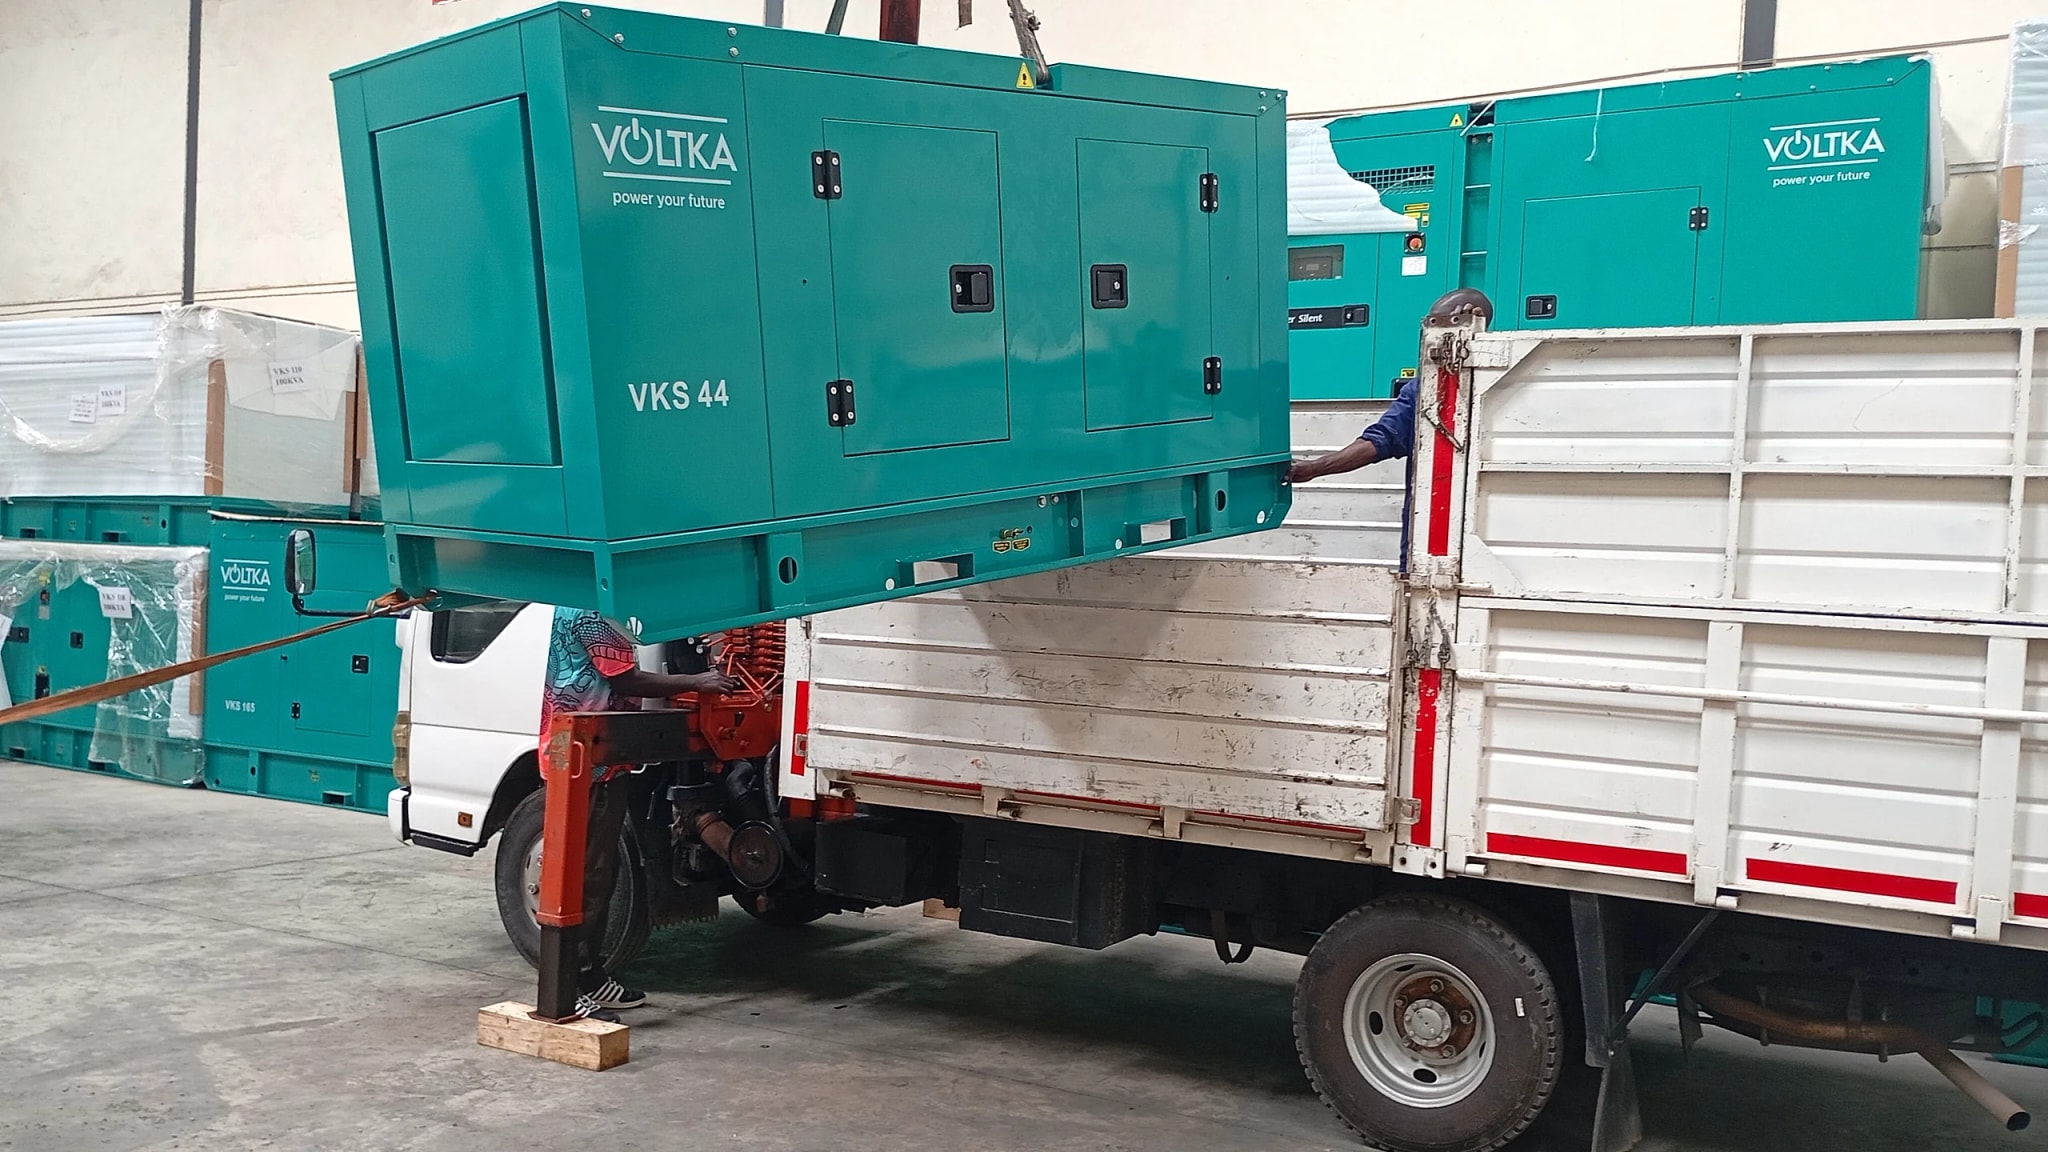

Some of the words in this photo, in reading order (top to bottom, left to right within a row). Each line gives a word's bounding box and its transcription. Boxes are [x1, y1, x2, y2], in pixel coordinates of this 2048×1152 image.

[591, 118, 738, 172] VOLTKA
[1762, 128, 1885, 162] VOLTKA
[1773, 176, 1807, 188] power
[1809, 174, 1834, 185] your
[1837, 171, 1870, 181] future
[612, 192, 653, 206] power
[657, 194, 685, 208] your
[688, 193, 725, 209] future
[1298, 313, 1323, 323] Silent
[627, 381, 690, 412] VKS
[698, 379, 729, 408] 44
[220, 563, 271, 586] VOLTKA
[225, 700, 241, 711] VKS
[242, 702, 255, 713] 165
